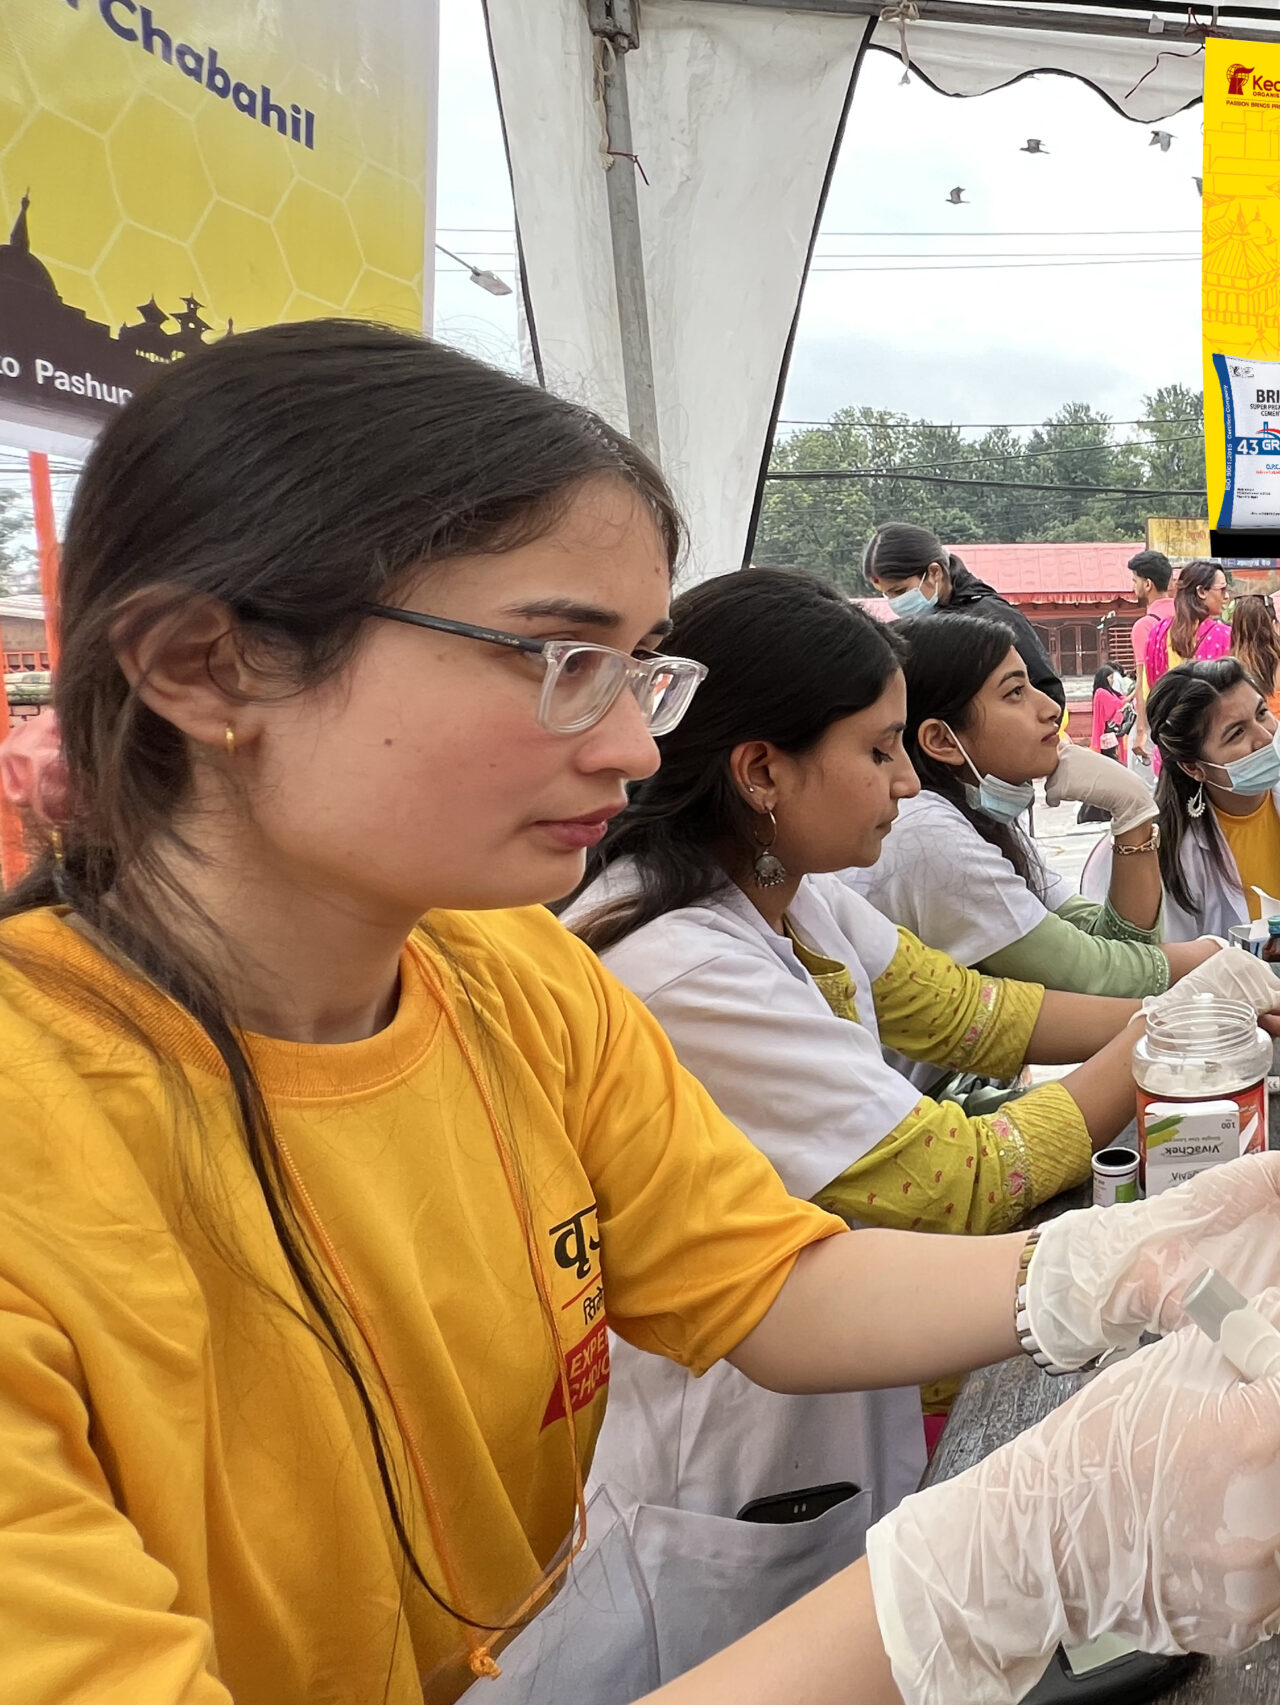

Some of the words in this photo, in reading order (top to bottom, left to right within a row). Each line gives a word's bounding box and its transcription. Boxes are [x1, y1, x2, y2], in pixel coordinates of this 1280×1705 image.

[98, 0, 316, 151] Chabahil
[1250, 101, 1270, 109] BRINGS
[0, 356, 20, 378] o
[1237, 439, 1259, 455] 43
[1221, 1121, 1236, 1130] 100
[1164, 1144, 1221, 1156] VivaChek
[1171, 1171, 1197, 1181] Viva
[569, 1329, 608, 1380] EXPE
